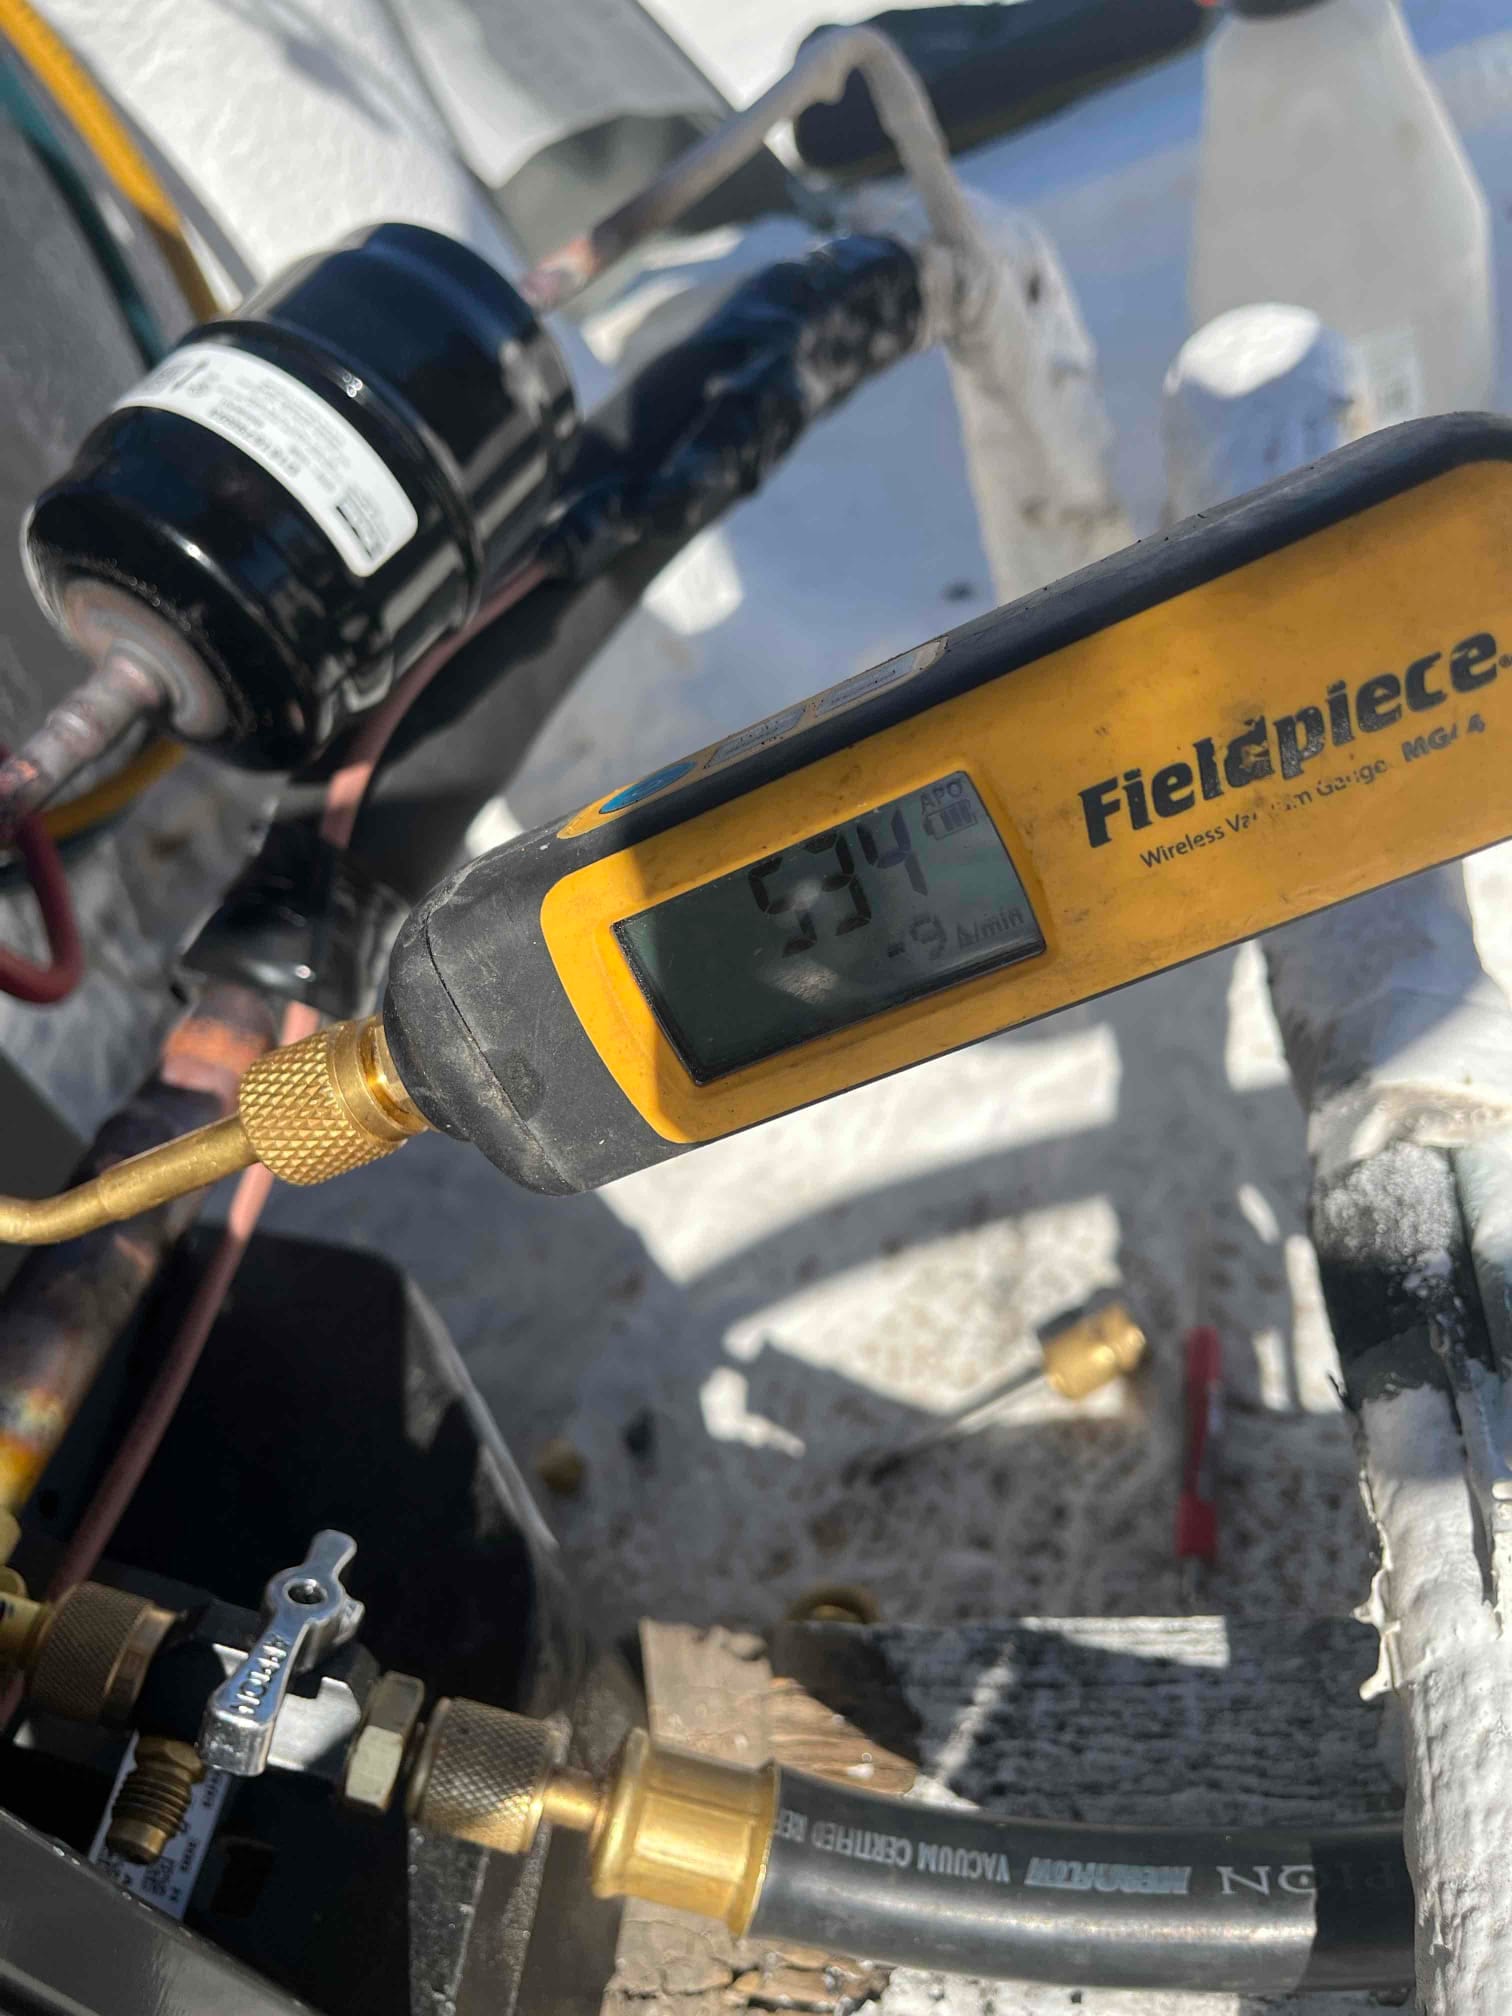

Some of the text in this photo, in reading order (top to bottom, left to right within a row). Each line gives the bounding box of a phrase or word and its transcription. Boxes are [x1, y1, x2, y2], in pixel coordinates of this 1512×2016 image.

[920, 780, 963, 813] APO
[1139, 825, 1226, 869] Wireless
[1225, 791, 1314, 834] Vam
[749, 808, 929, 958] 534
[810, 1820, 914, 1868] CERTIFIED
[918, 1841, 1012, 1885] VACUUM
